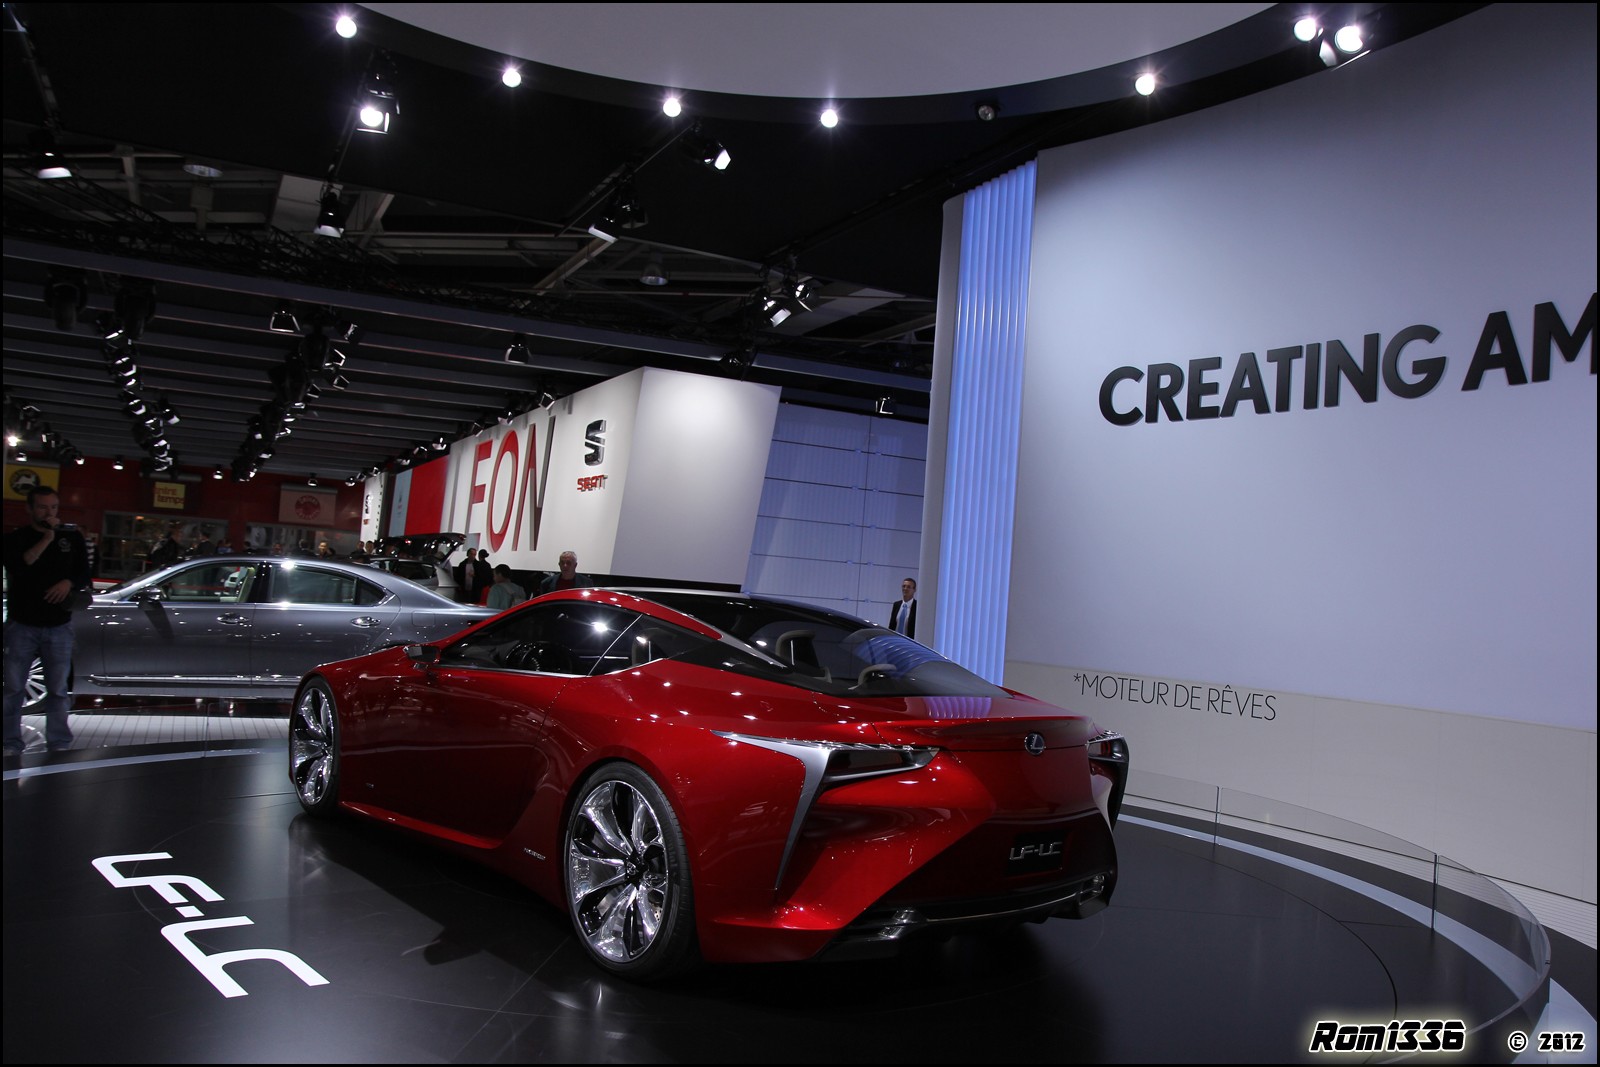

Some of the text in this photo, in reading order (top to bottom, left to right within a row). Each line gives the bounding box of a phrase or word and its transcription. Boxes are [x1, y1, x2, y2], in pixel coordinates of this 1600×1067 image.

[1099, 324, 1447, 426] CREATING
[577, 474, 608, 492] SEAT
[1174, 684, 1202, 710] DE
[1207, 684, 1277, 721] RÊVES
[1009, 842, 1063, 860] LF-LC
